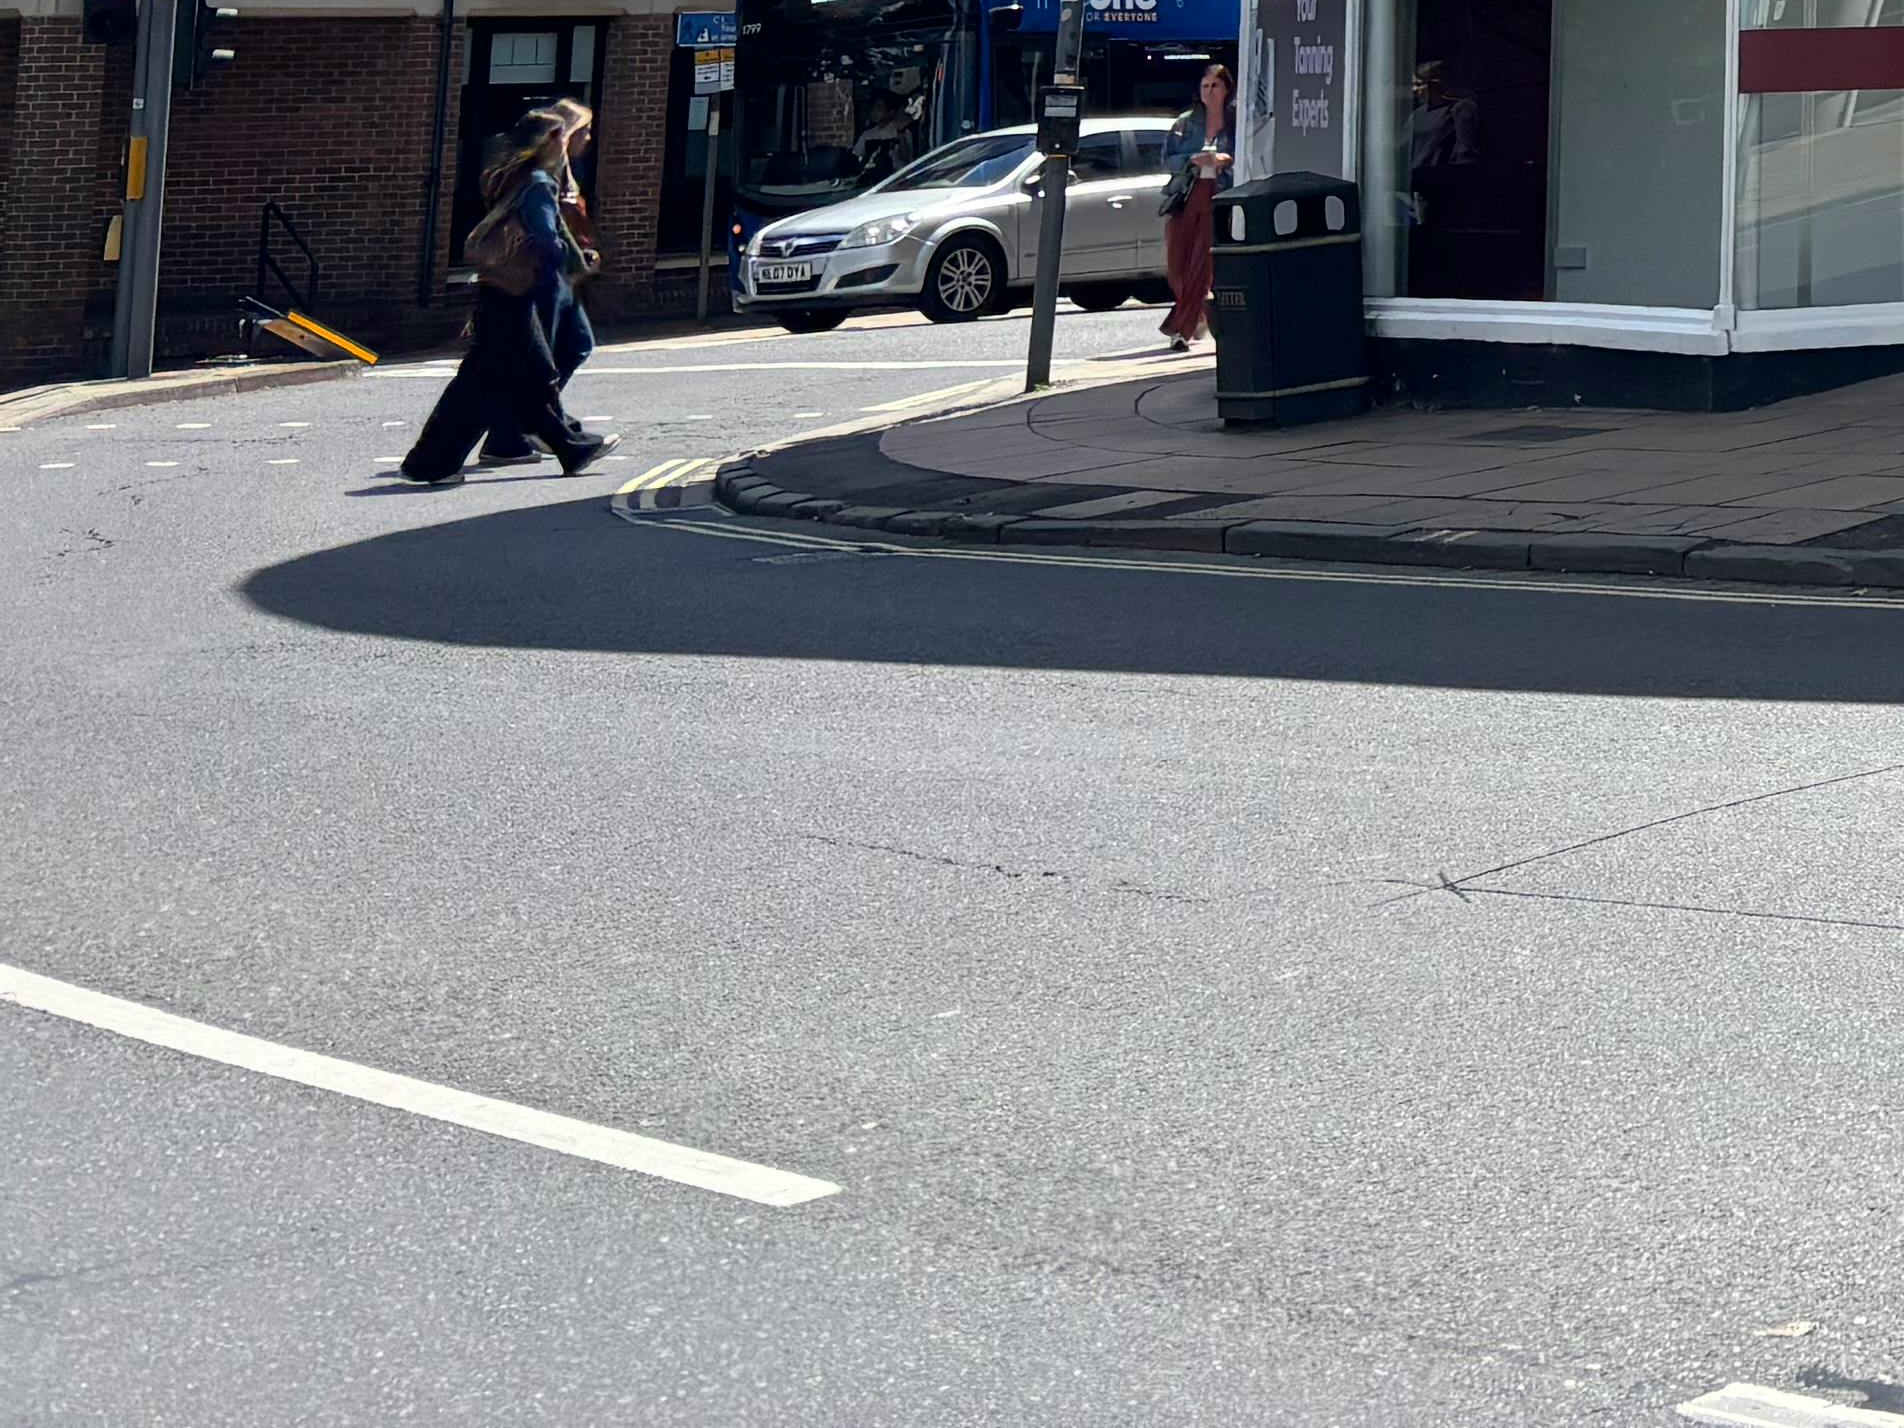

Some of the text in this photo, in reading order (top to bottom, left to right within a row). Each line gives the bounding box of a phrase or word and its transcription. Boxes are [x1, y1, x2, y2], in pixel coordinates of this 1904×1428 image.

[1103, 11, 1158, 22] EVERYONE
[1293, 36, 1334, 85] Tanning
[1292, 89, 1329, 137] Experts
